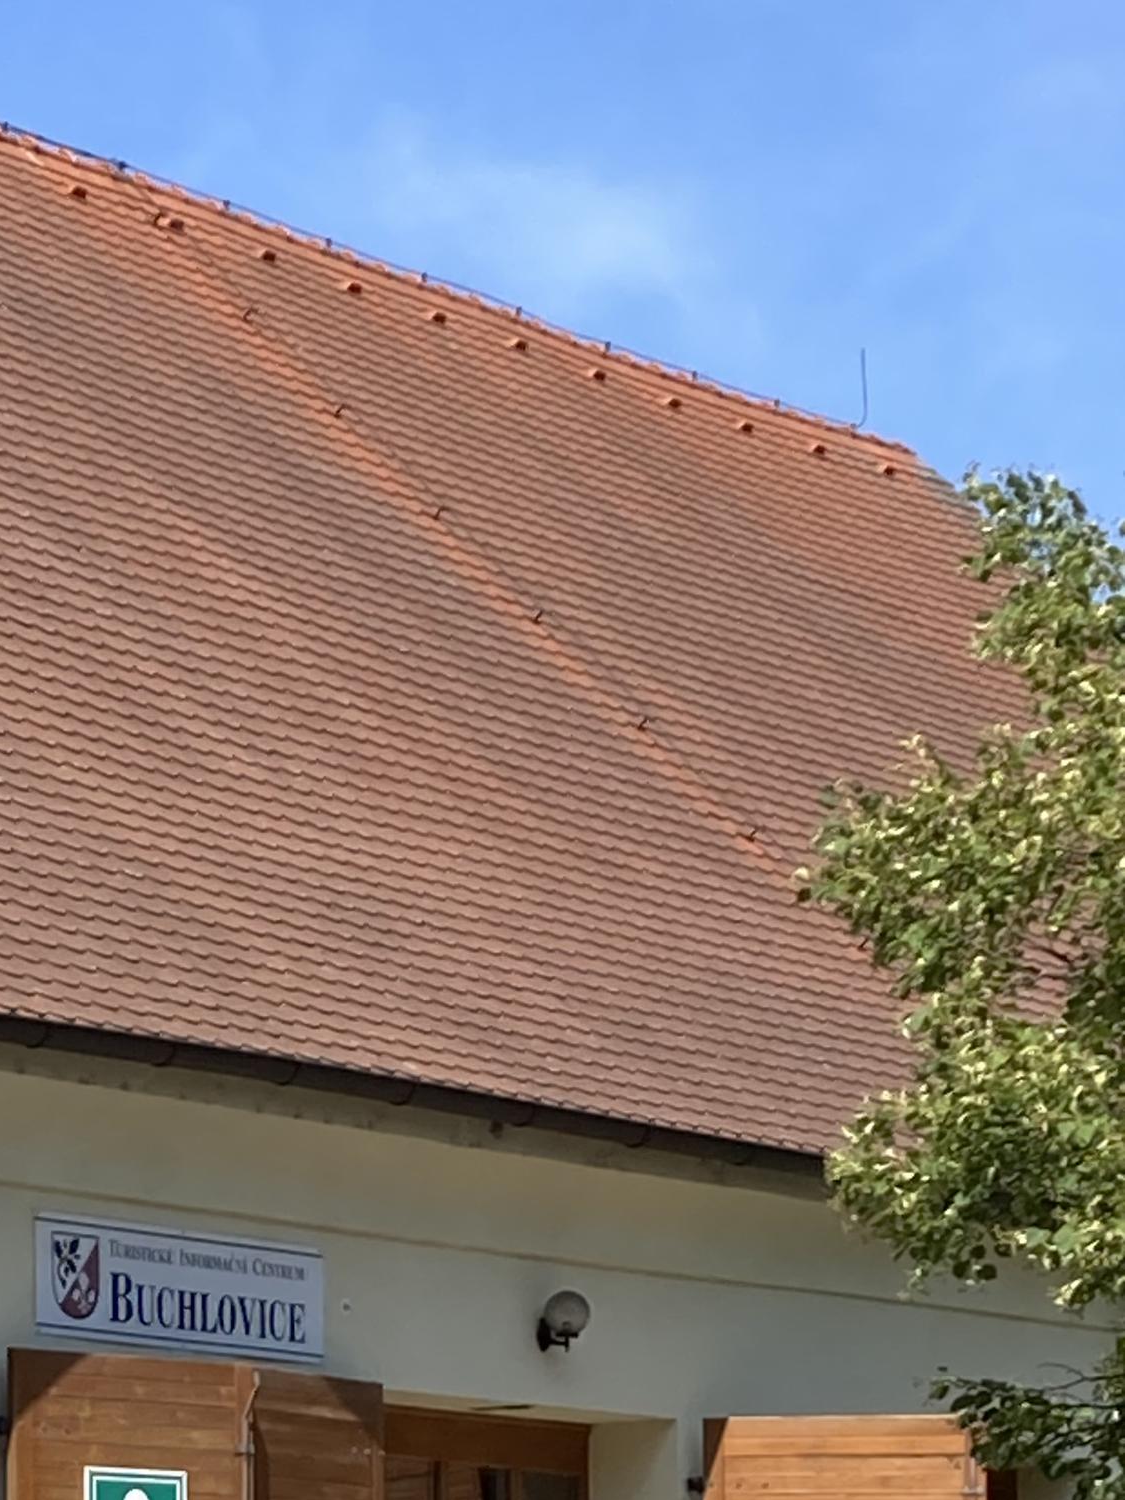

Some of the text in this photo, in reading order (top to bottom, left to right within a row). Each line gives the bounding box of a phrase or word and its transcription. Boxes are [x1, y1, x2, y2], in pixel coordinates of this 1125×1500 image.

[108, 1239, 305, 1281] TURISTICKÉ INFORMAČNÍ CENTRUM
[109, 1271, 307, 1345] BUCHLOVICE
